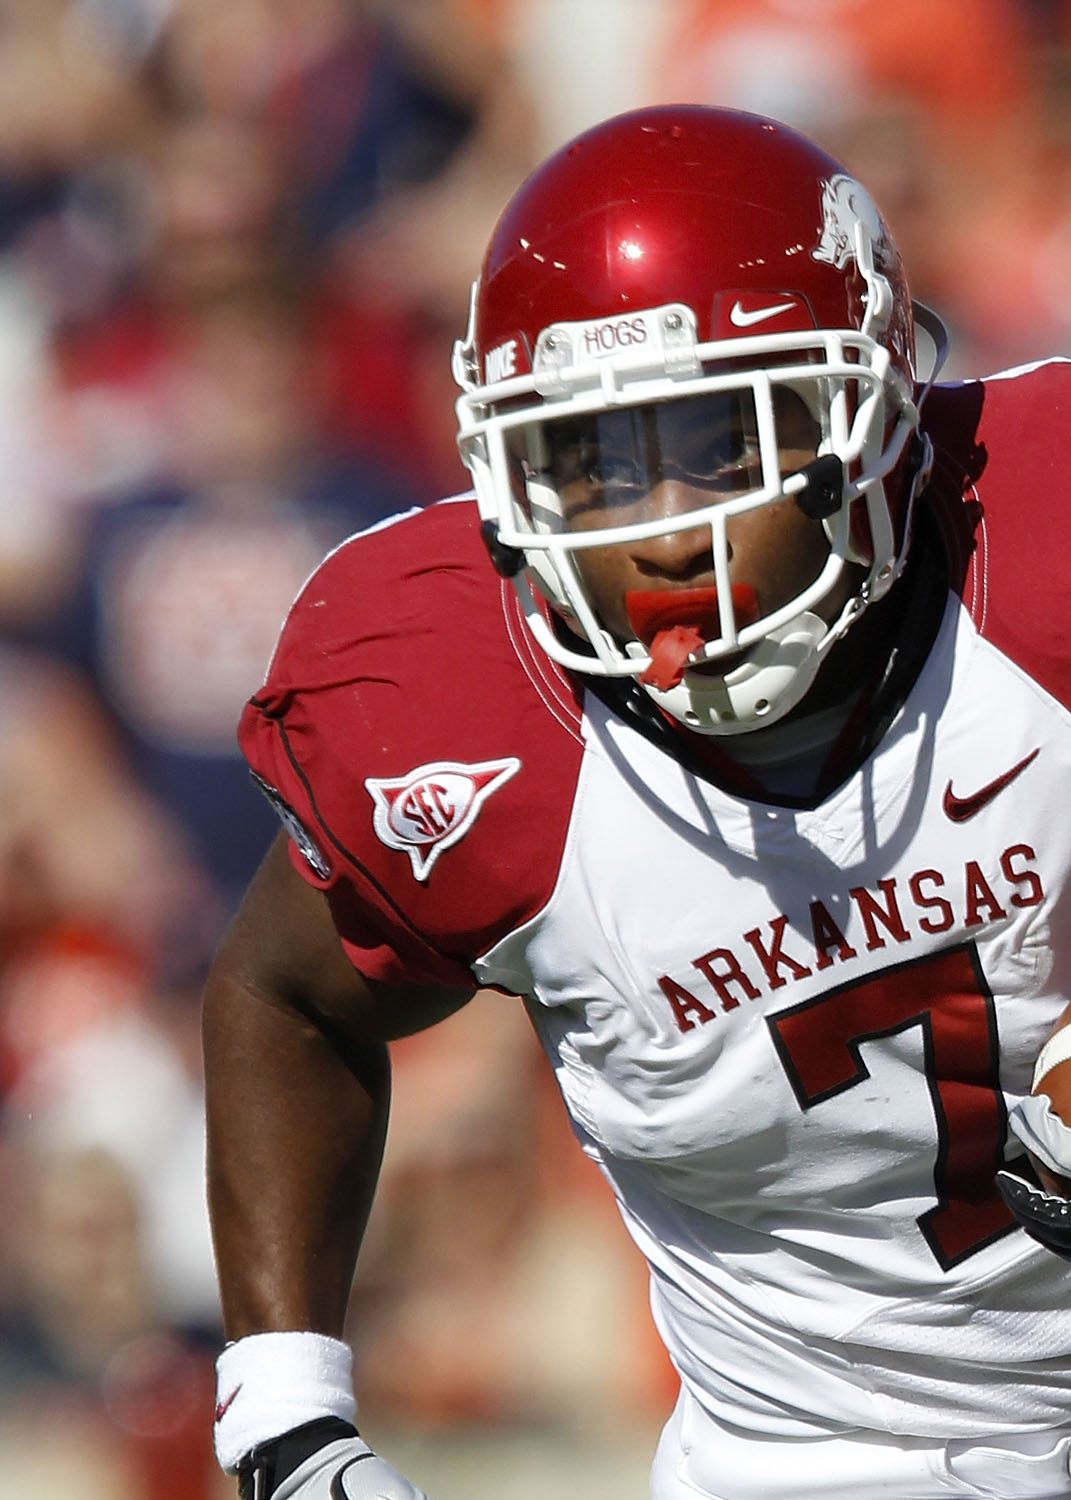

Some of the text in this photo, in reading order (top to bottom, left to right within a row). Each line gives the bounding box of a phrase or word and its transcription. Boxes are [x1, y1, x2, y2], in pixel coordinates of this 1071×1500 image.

[584, 318, 647, 354] HOGS
[402, 783, 455, 837] SEC
[657, 844, 1044, 1033] ARKANSAS
[765, 939, 1040, 1274] 7
